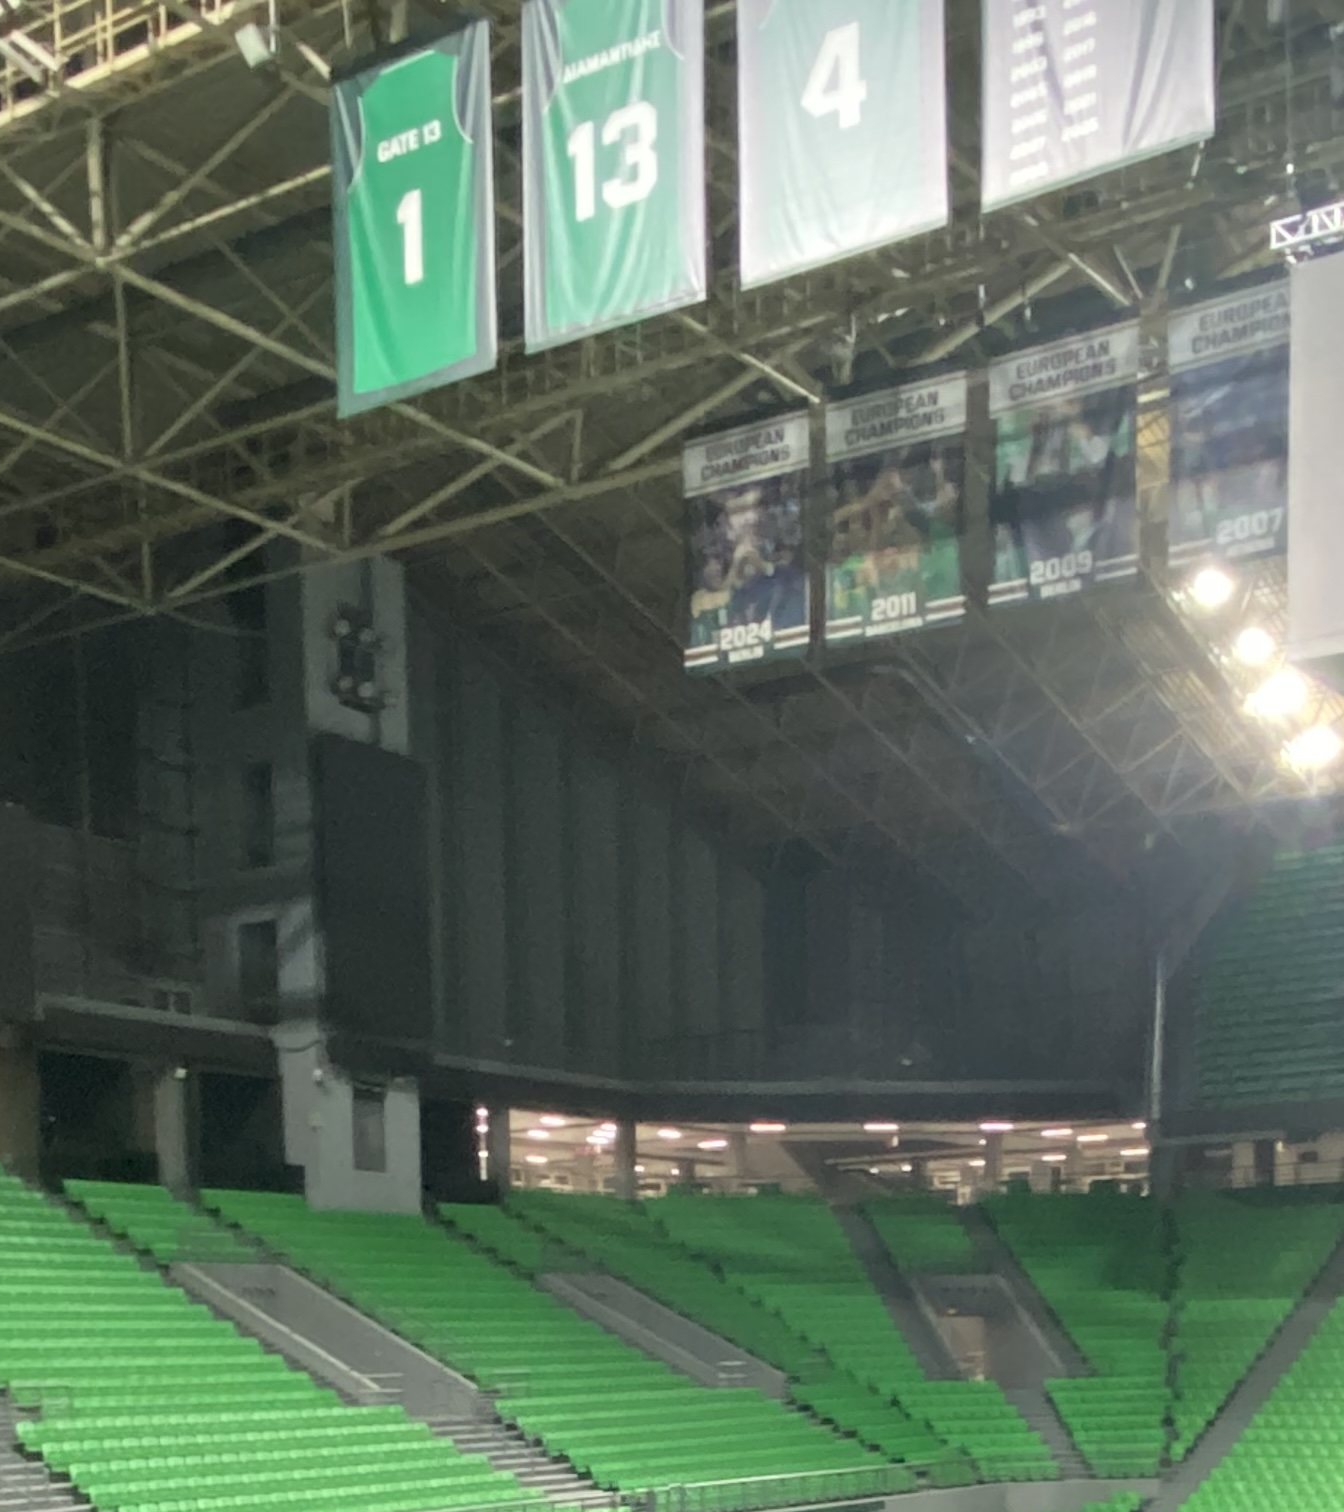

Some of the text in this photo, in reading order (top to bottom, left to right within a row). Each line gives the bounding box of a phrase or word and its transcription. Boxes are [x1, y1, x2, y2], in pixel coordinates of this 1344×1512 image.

[800, 20, 867, 130] 4
[377, 118, 441, 163] GATE 13
[567, 100, 658, 222] 13
[396, 188, 423, 285] 1
[1016, 340, 1110, 379] EUROPEAN
[1008, 359, 1117, 401] CHAMPIONS
[844, 407, 946, 446] CHAMPIONS
[701, 444, 791, 481] CHAMPIONS
[1216, 507, 1284, 546] 2007
[1030, 550, 1093, 586] 2009
[871, 592, 917, 622] 2011
[720, 618, 772, 651] 2024
